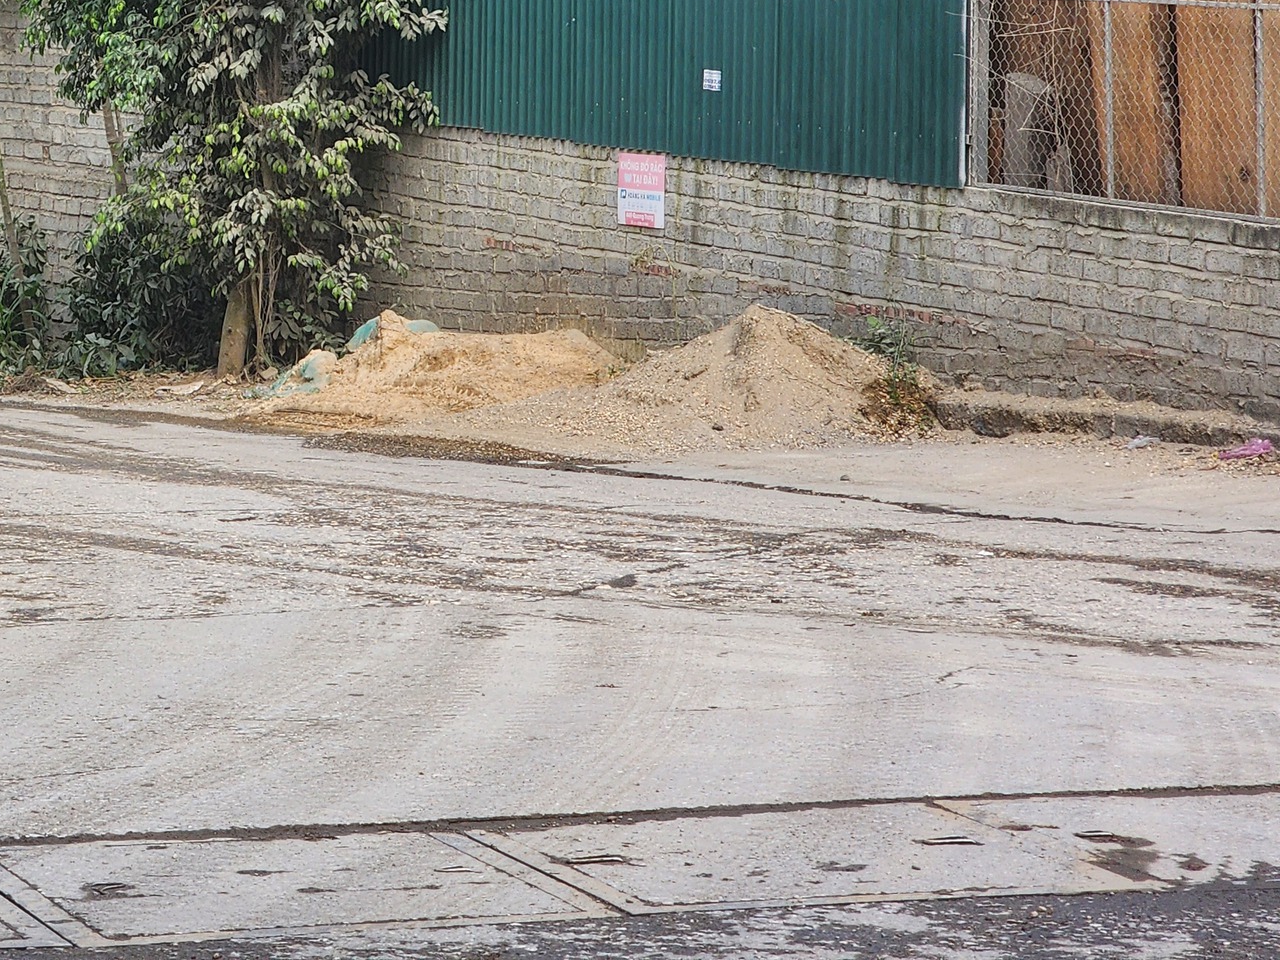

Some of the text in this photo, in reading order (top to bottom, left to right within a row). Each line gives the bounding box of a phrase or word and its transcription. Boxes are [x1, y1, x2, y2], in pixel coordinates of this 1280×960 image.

[621, 159, 639, 171] KHÔNG
[650, 160, 663, 173] RÁC
[633, 173, 642, 187] TẠI
